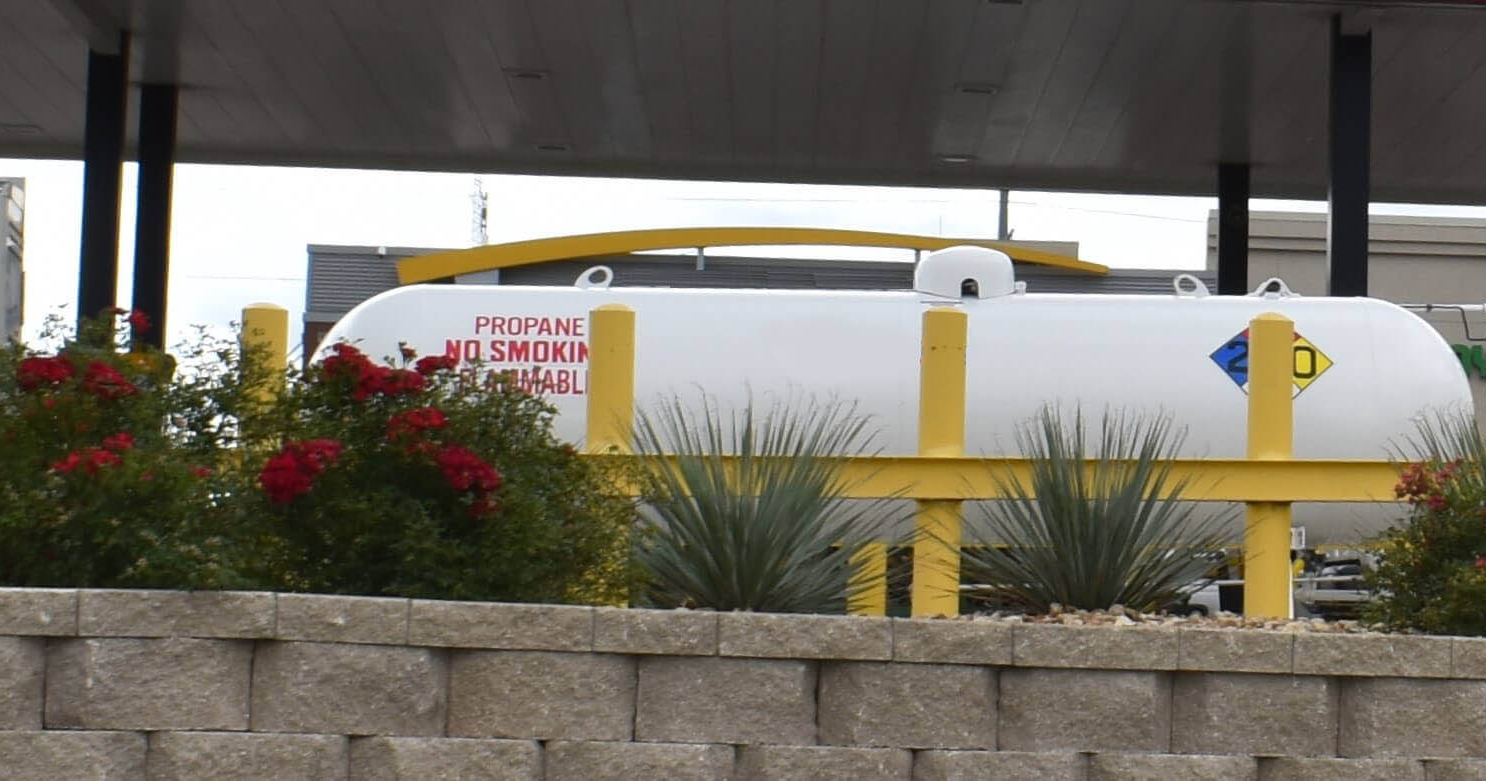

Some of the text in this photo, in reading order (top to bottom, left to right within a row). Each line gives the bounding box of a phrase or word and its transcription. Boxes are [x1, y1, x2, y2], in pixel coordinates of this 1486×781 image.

[475, 316, 585, 336] PROPANE
[445, 339, 589, 363] NO SMOKIN
[459, 368, 589, 395] FAMMABL
